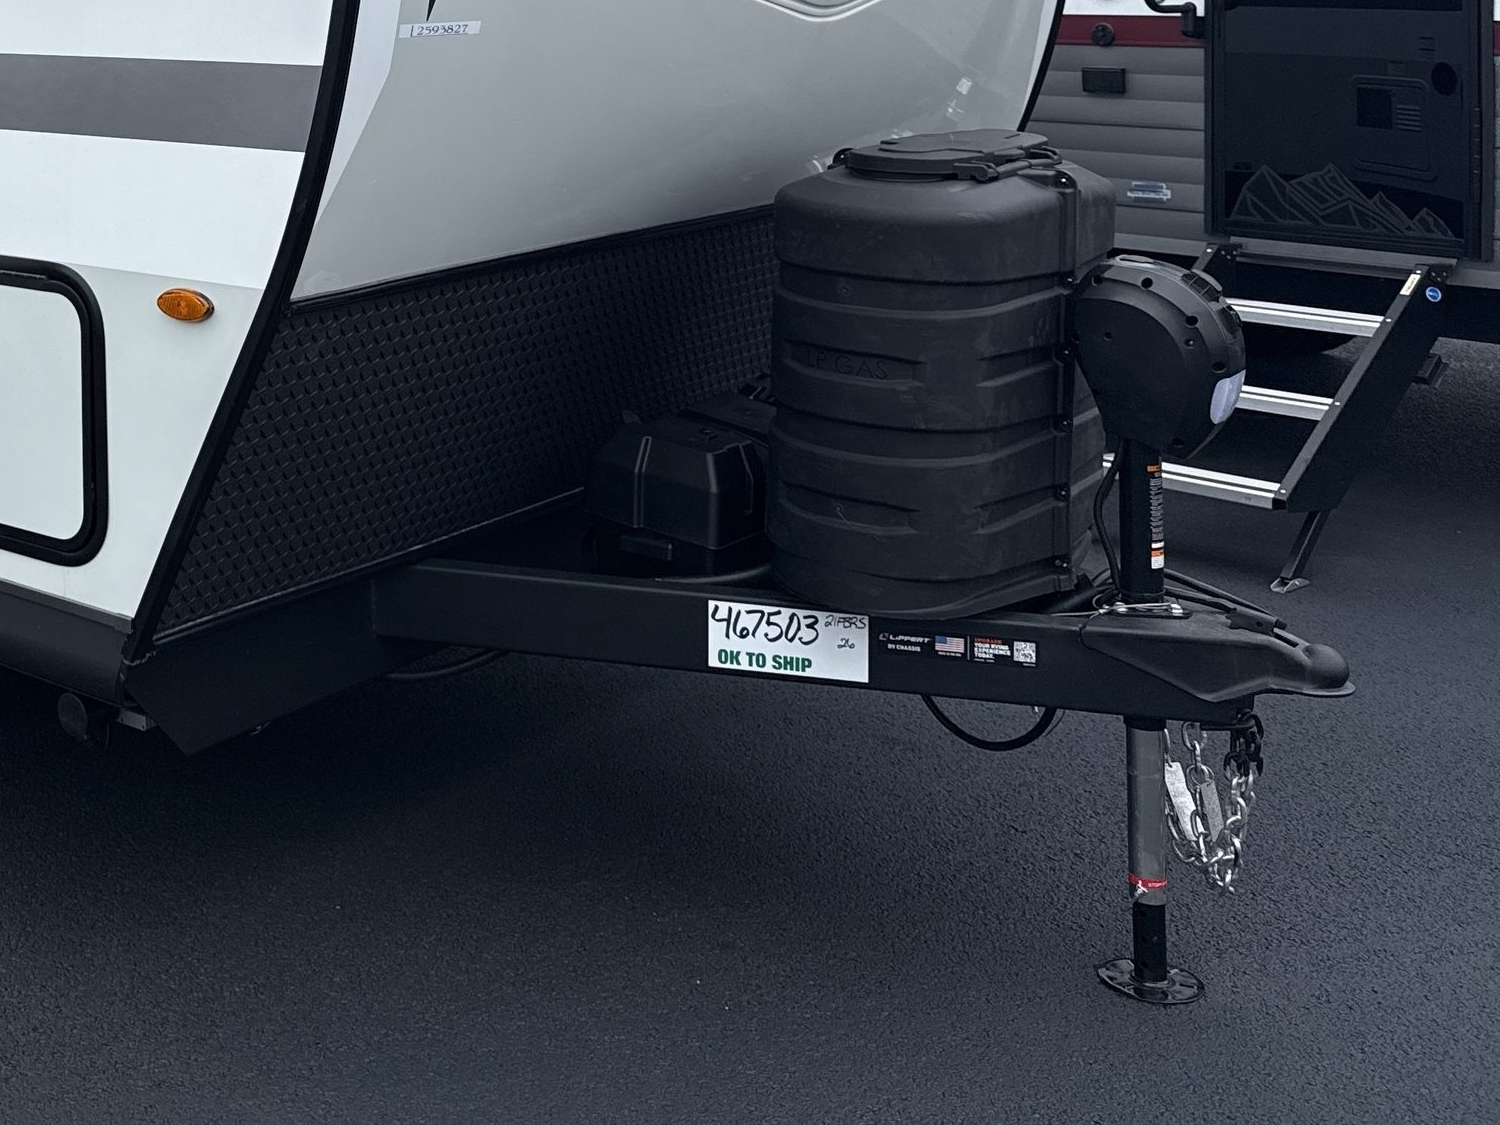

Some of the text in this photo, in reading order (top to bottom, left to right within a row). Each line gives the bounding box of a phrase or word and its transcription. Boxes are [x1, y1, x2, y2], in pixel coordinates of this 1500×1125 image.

[835, 354, 888, 380] GAS
[710, 603, 820, 646] 467503
[889, 634, 931, 643] LIPPERT
[896, 644, 921, 652] CHASSIS
[717, 648, 812, 673] OK TO SHIP
